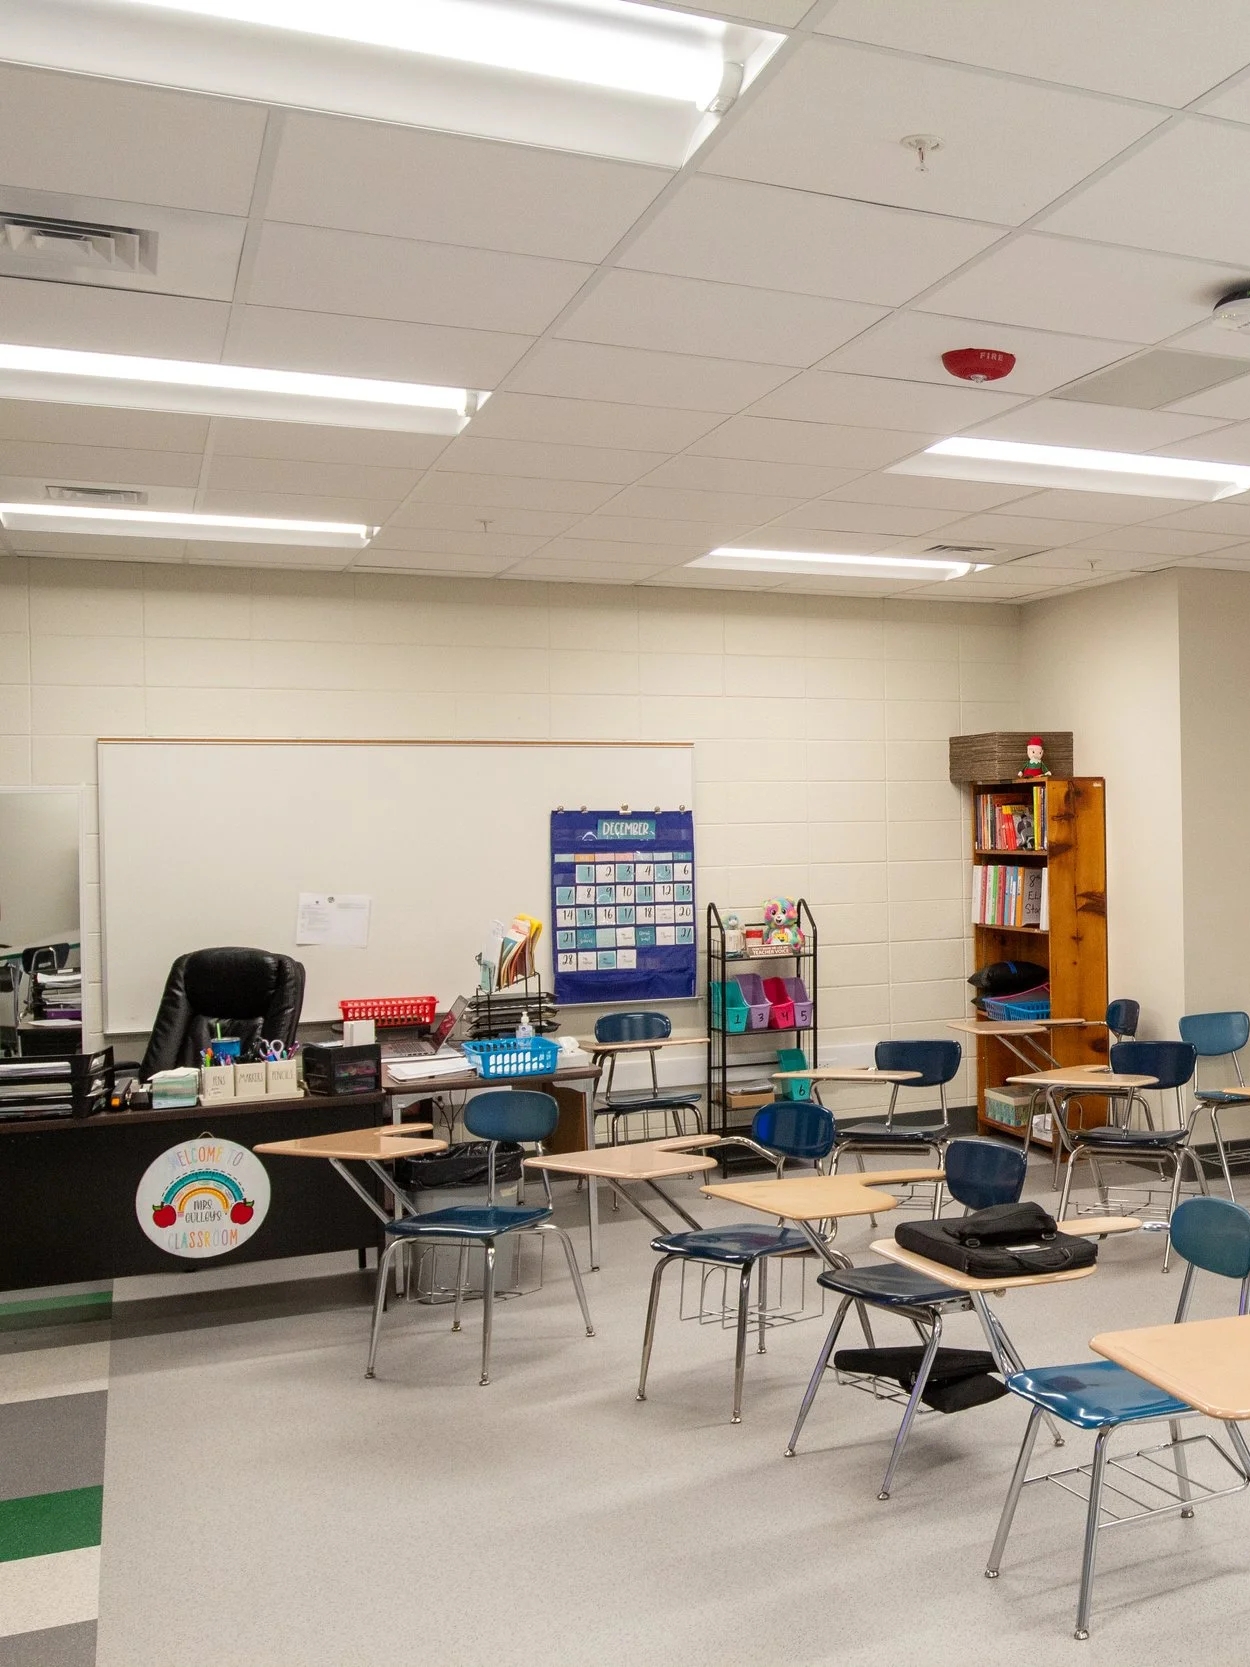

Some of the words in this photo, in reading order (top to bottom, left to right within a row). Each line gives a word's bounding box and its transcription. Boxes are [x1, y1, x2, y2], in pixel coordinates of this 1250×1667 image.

[980, 352, 1004, 361] FIRE
[602, 822, 649, 836] DECEMBER
[623, 887, 632, 897] 10
[644, 886, 651, 896] 11
[662, 885, 671, 895] 12
[682, 885, 690, 895] 13
[563, 910, 573, 920] 14
[584, 909, 593, 920] 15
[604, 909, 613, 919] 16
[645, 908, 652, 918] 18
[679, 907, 691, 916] 20
[563, 955, 573, 966] 28
[758, 1013, 764, 1022] 3
[782, 1011, 789, 1021] 4
[801, 1010, 808, 1021] 5
[798, 1085, 806, 1096] 6
[169, 1146, 225, 1168] WELCOME
[227, 1150, 244, 1167] TO
[168, 1229, 238, 1250] CLASSROOM
